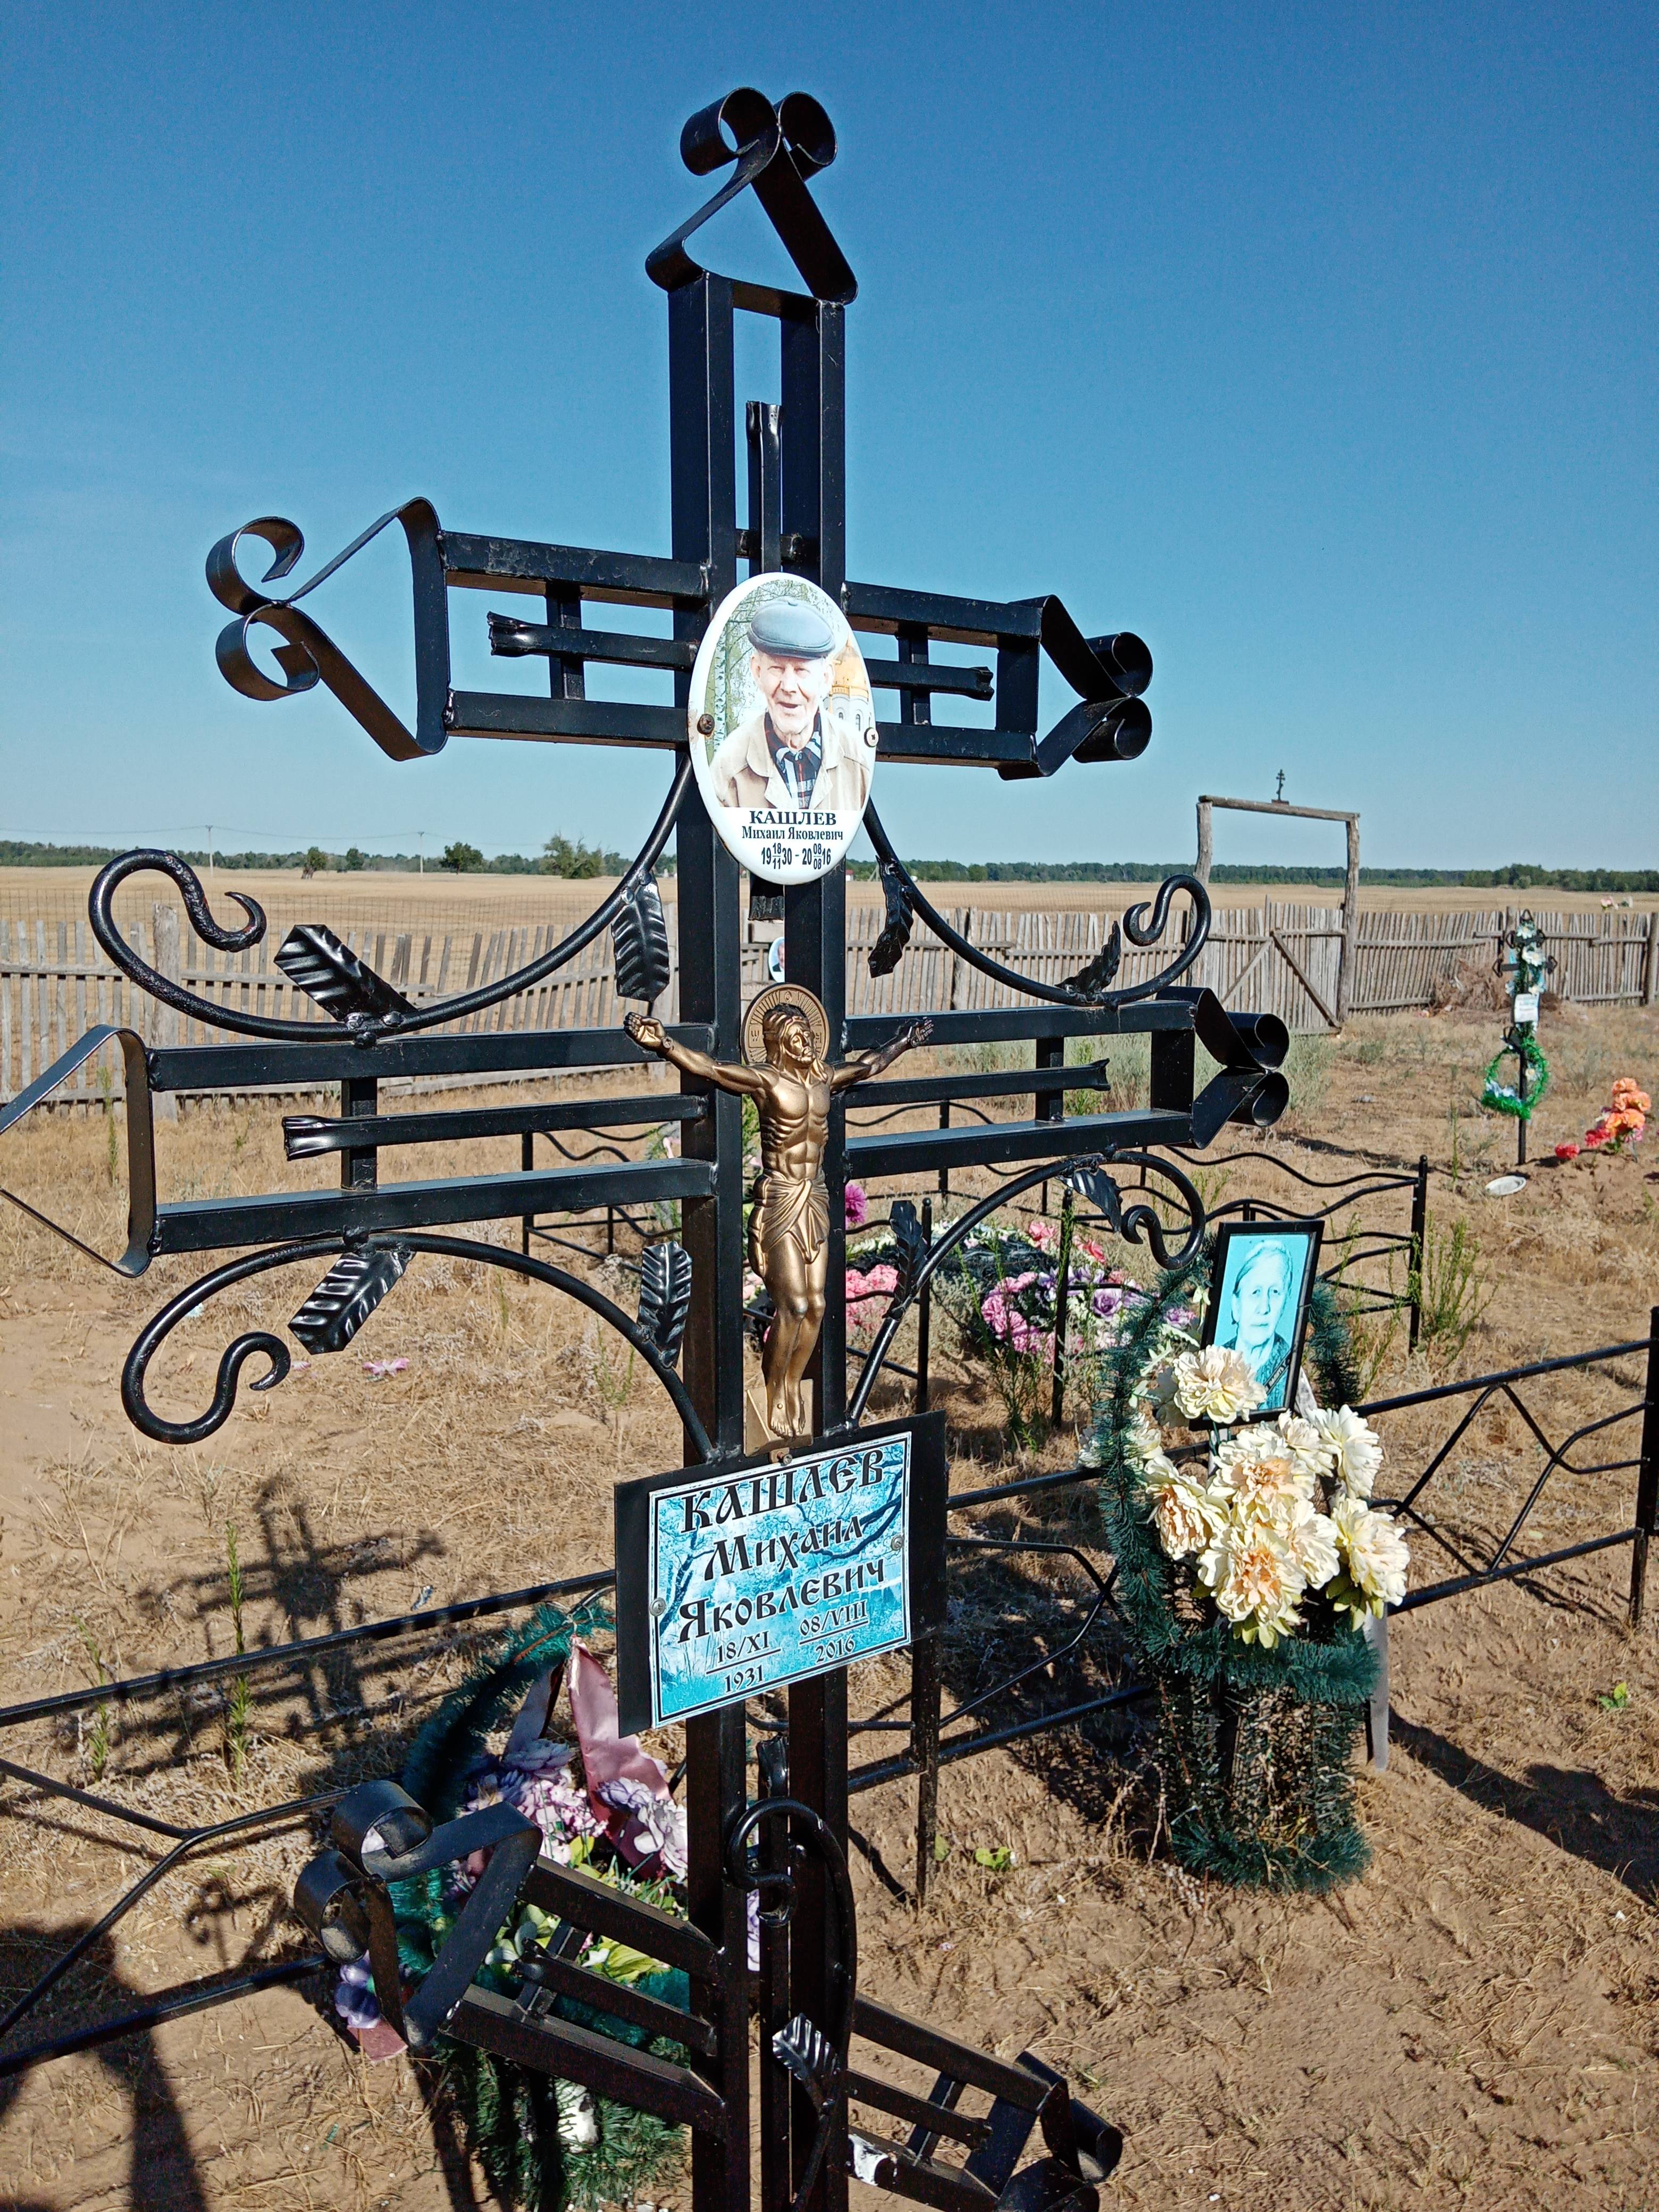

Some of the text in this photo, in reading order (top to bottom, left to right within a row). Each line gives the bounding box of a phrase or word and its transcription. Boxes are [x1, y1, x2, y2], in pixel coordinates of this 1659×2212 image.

[749, 810, 837, 825] КАШЛЕВ
[742, 826, 843, 841] Михаил Яковлевич
[773, 843, 822, 854] 18 08
[773, 858, 822, 870] 11 08
[703, 1515, 864, 1582] Михаил
[677, 1559, 885, 1644] Яковлевич
[724, 1635, 856, 1694] 1931 2016
